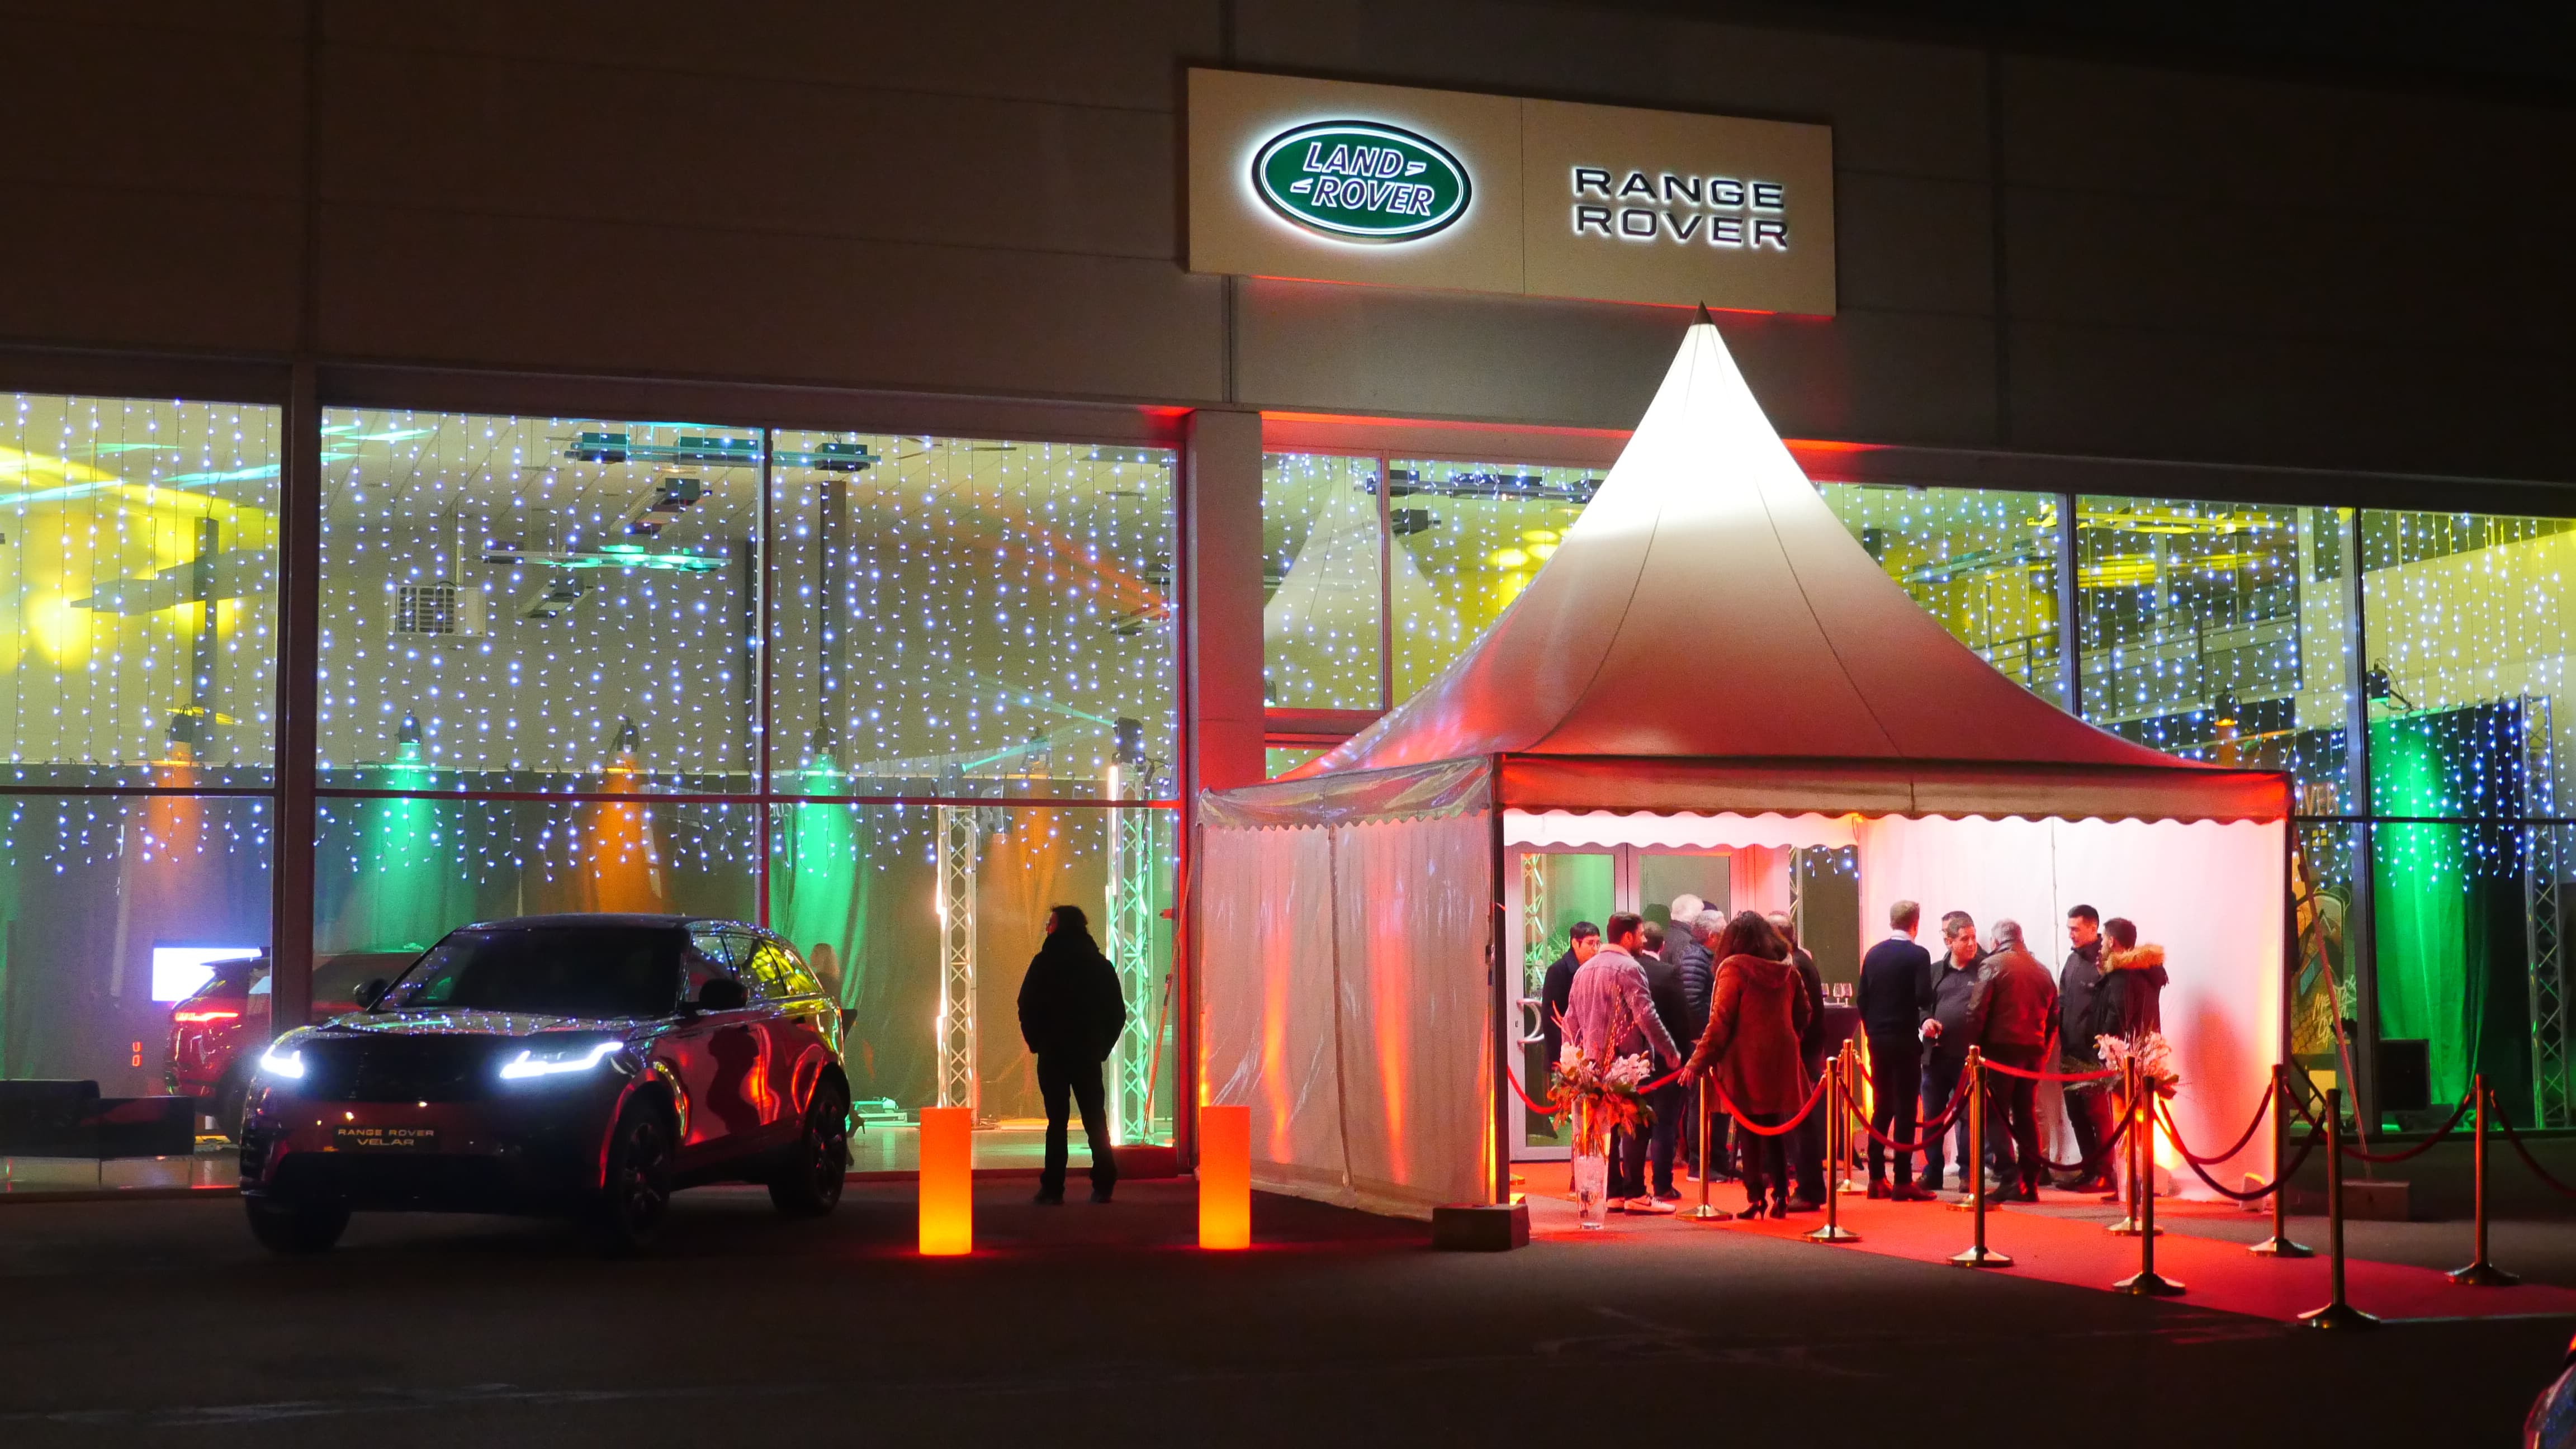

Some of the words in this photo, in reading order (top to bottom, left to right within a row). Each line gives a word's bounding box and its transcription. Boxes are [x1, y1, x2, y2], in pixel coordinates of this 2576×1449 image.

[1303, 141, 1404, 178] LAND
[1311, 176, 1435, 216] ROVER
[1574, 167, 1784, 210] RANGE
[1574, 205, 1788, 249] ROVER
